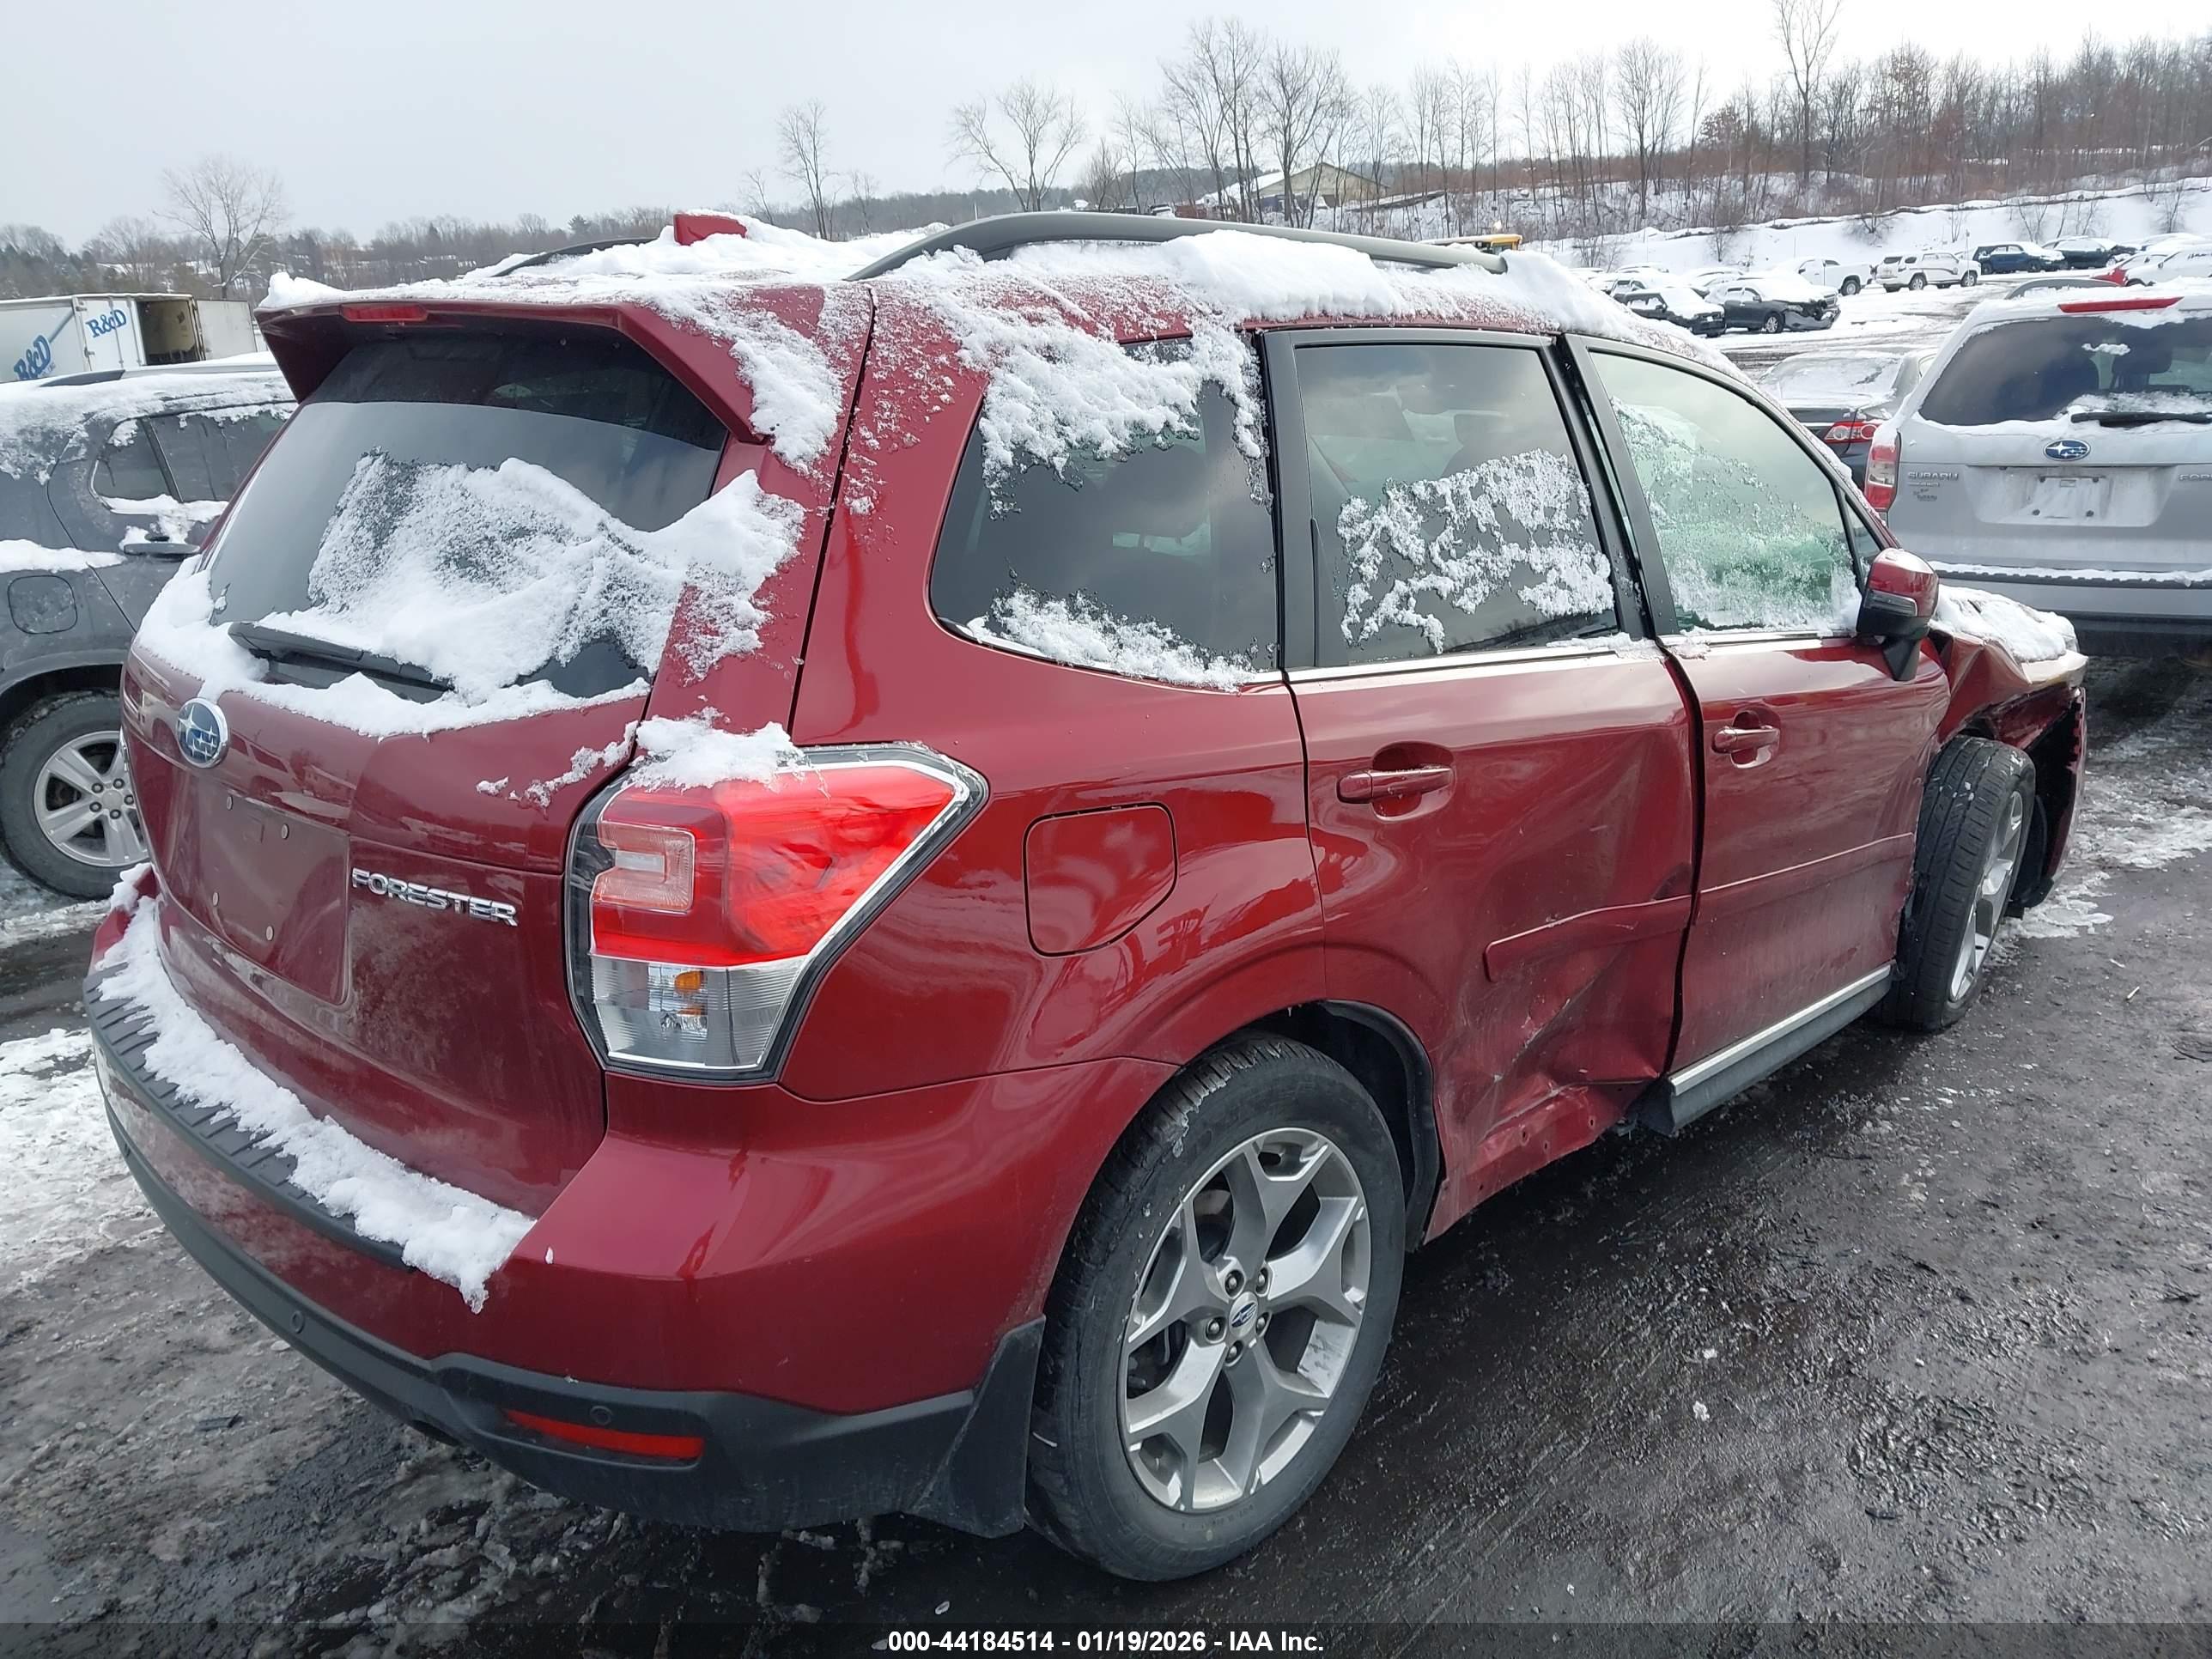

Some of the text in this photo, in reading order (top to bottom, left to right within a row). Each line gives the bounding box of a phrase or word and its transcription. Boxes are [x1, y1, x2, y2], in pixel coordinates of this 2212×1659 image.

[86, 309, 127, 338] R&D
[14, 335, 51, 380] R&D
[1908, 471, 1959, 481] SUBARU
[352, 867, 519, 927] FORESTER
